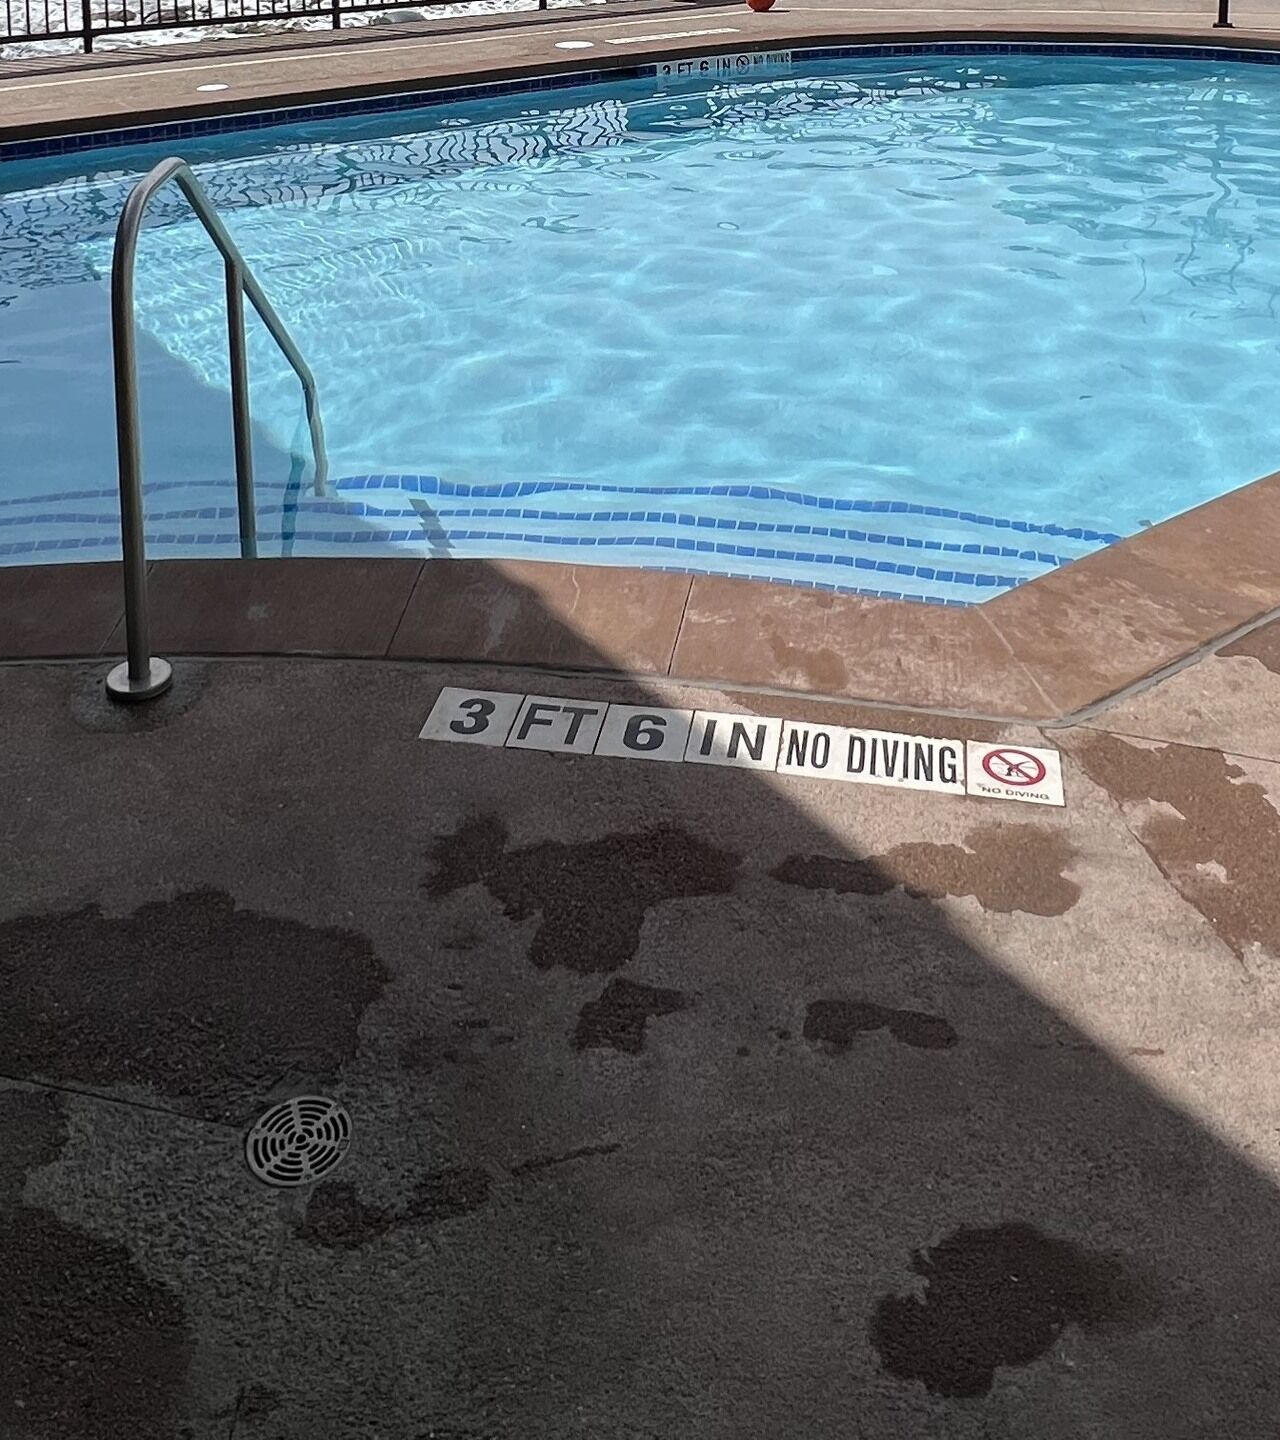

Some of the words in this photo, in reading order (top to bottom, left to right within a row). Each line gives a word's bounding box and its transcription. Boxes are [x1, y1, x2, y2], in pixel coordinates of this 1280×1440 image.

[449, 698, 496, 735] 3
[516, 703, 598, 745] FT
[623, 714, 667, 751] 6
[699, 719, 767, 761] IN
[785, 729, 831, 769] NO
[846, 734, 957, 784] DIVING
[981, 786, 1002, 794] NO
[1005, 789, 1050, 800] DIVING
